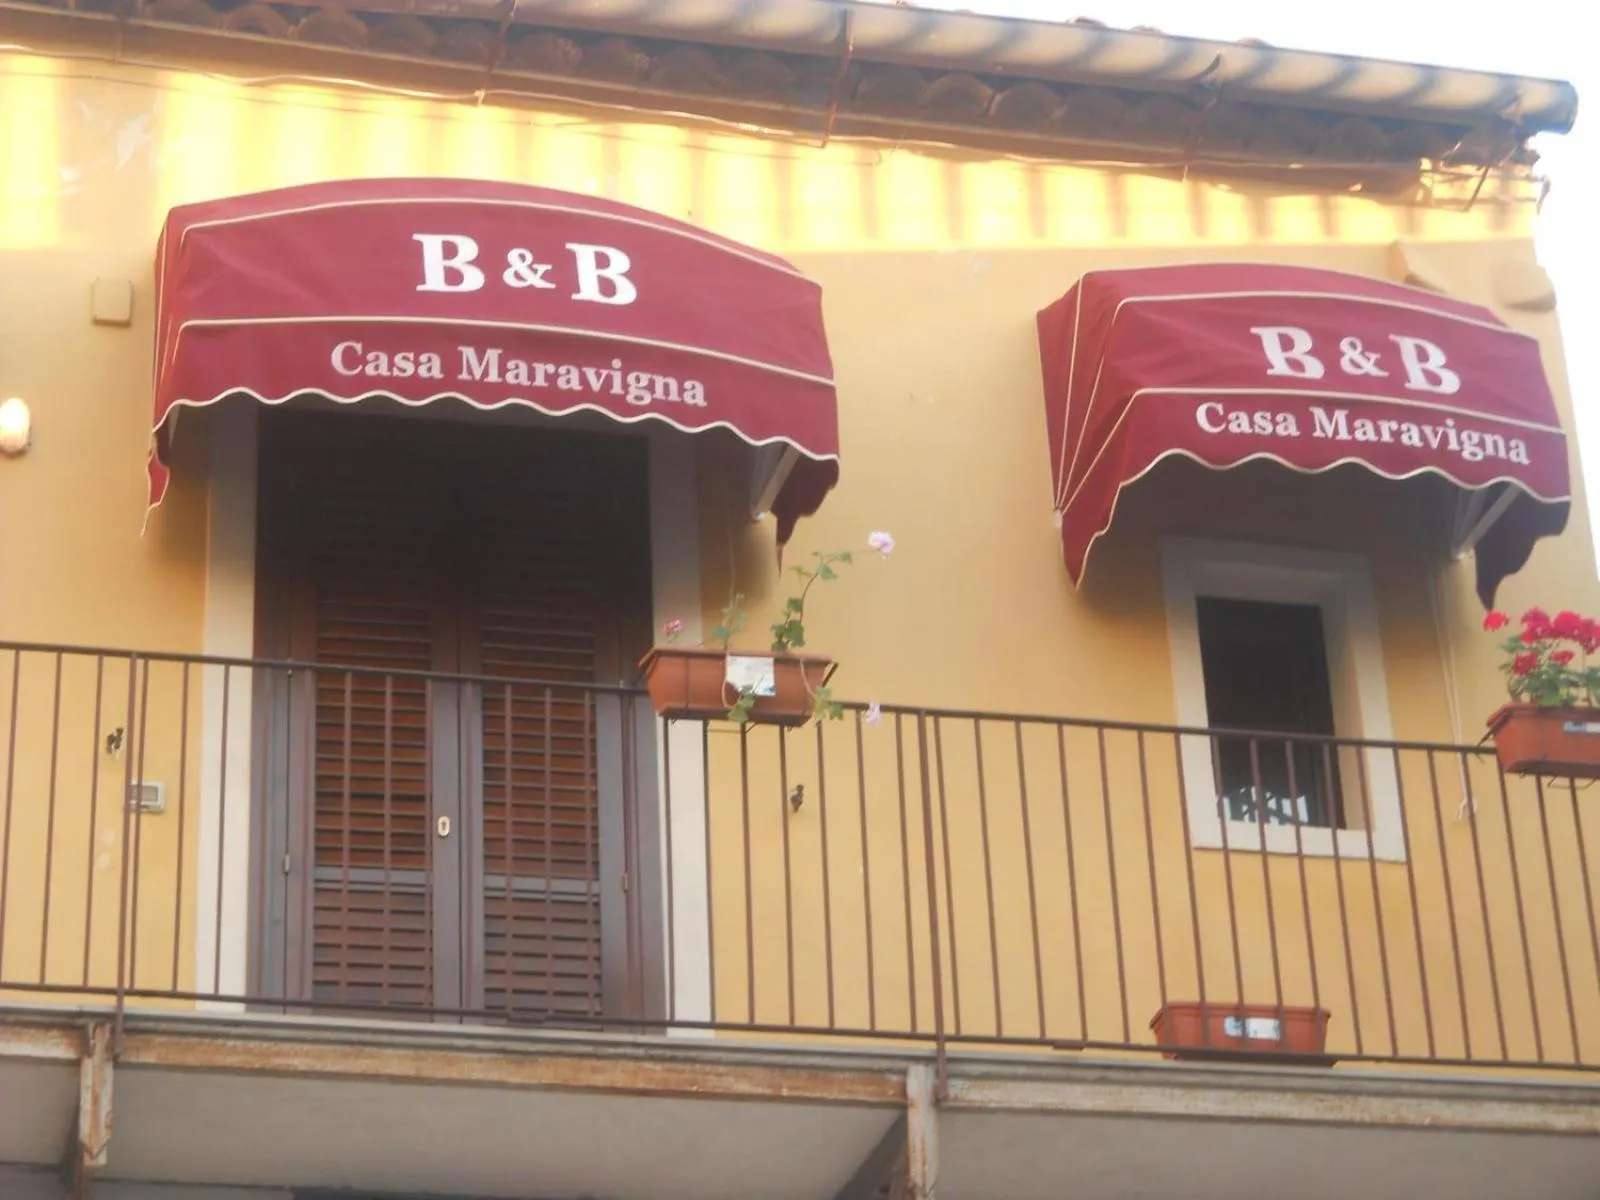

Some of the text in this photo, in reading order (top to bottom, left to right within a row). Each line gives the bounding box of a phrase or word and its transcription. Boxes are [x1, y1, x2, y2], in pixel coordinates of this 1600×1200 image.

[411, 232, 639, 306] B & B
[329, 340, 708, 408] Casa Maravigna
[1249, 325, 1462, 396] B & B
[1195, 400, 1532, 466] Casa Maravigna
